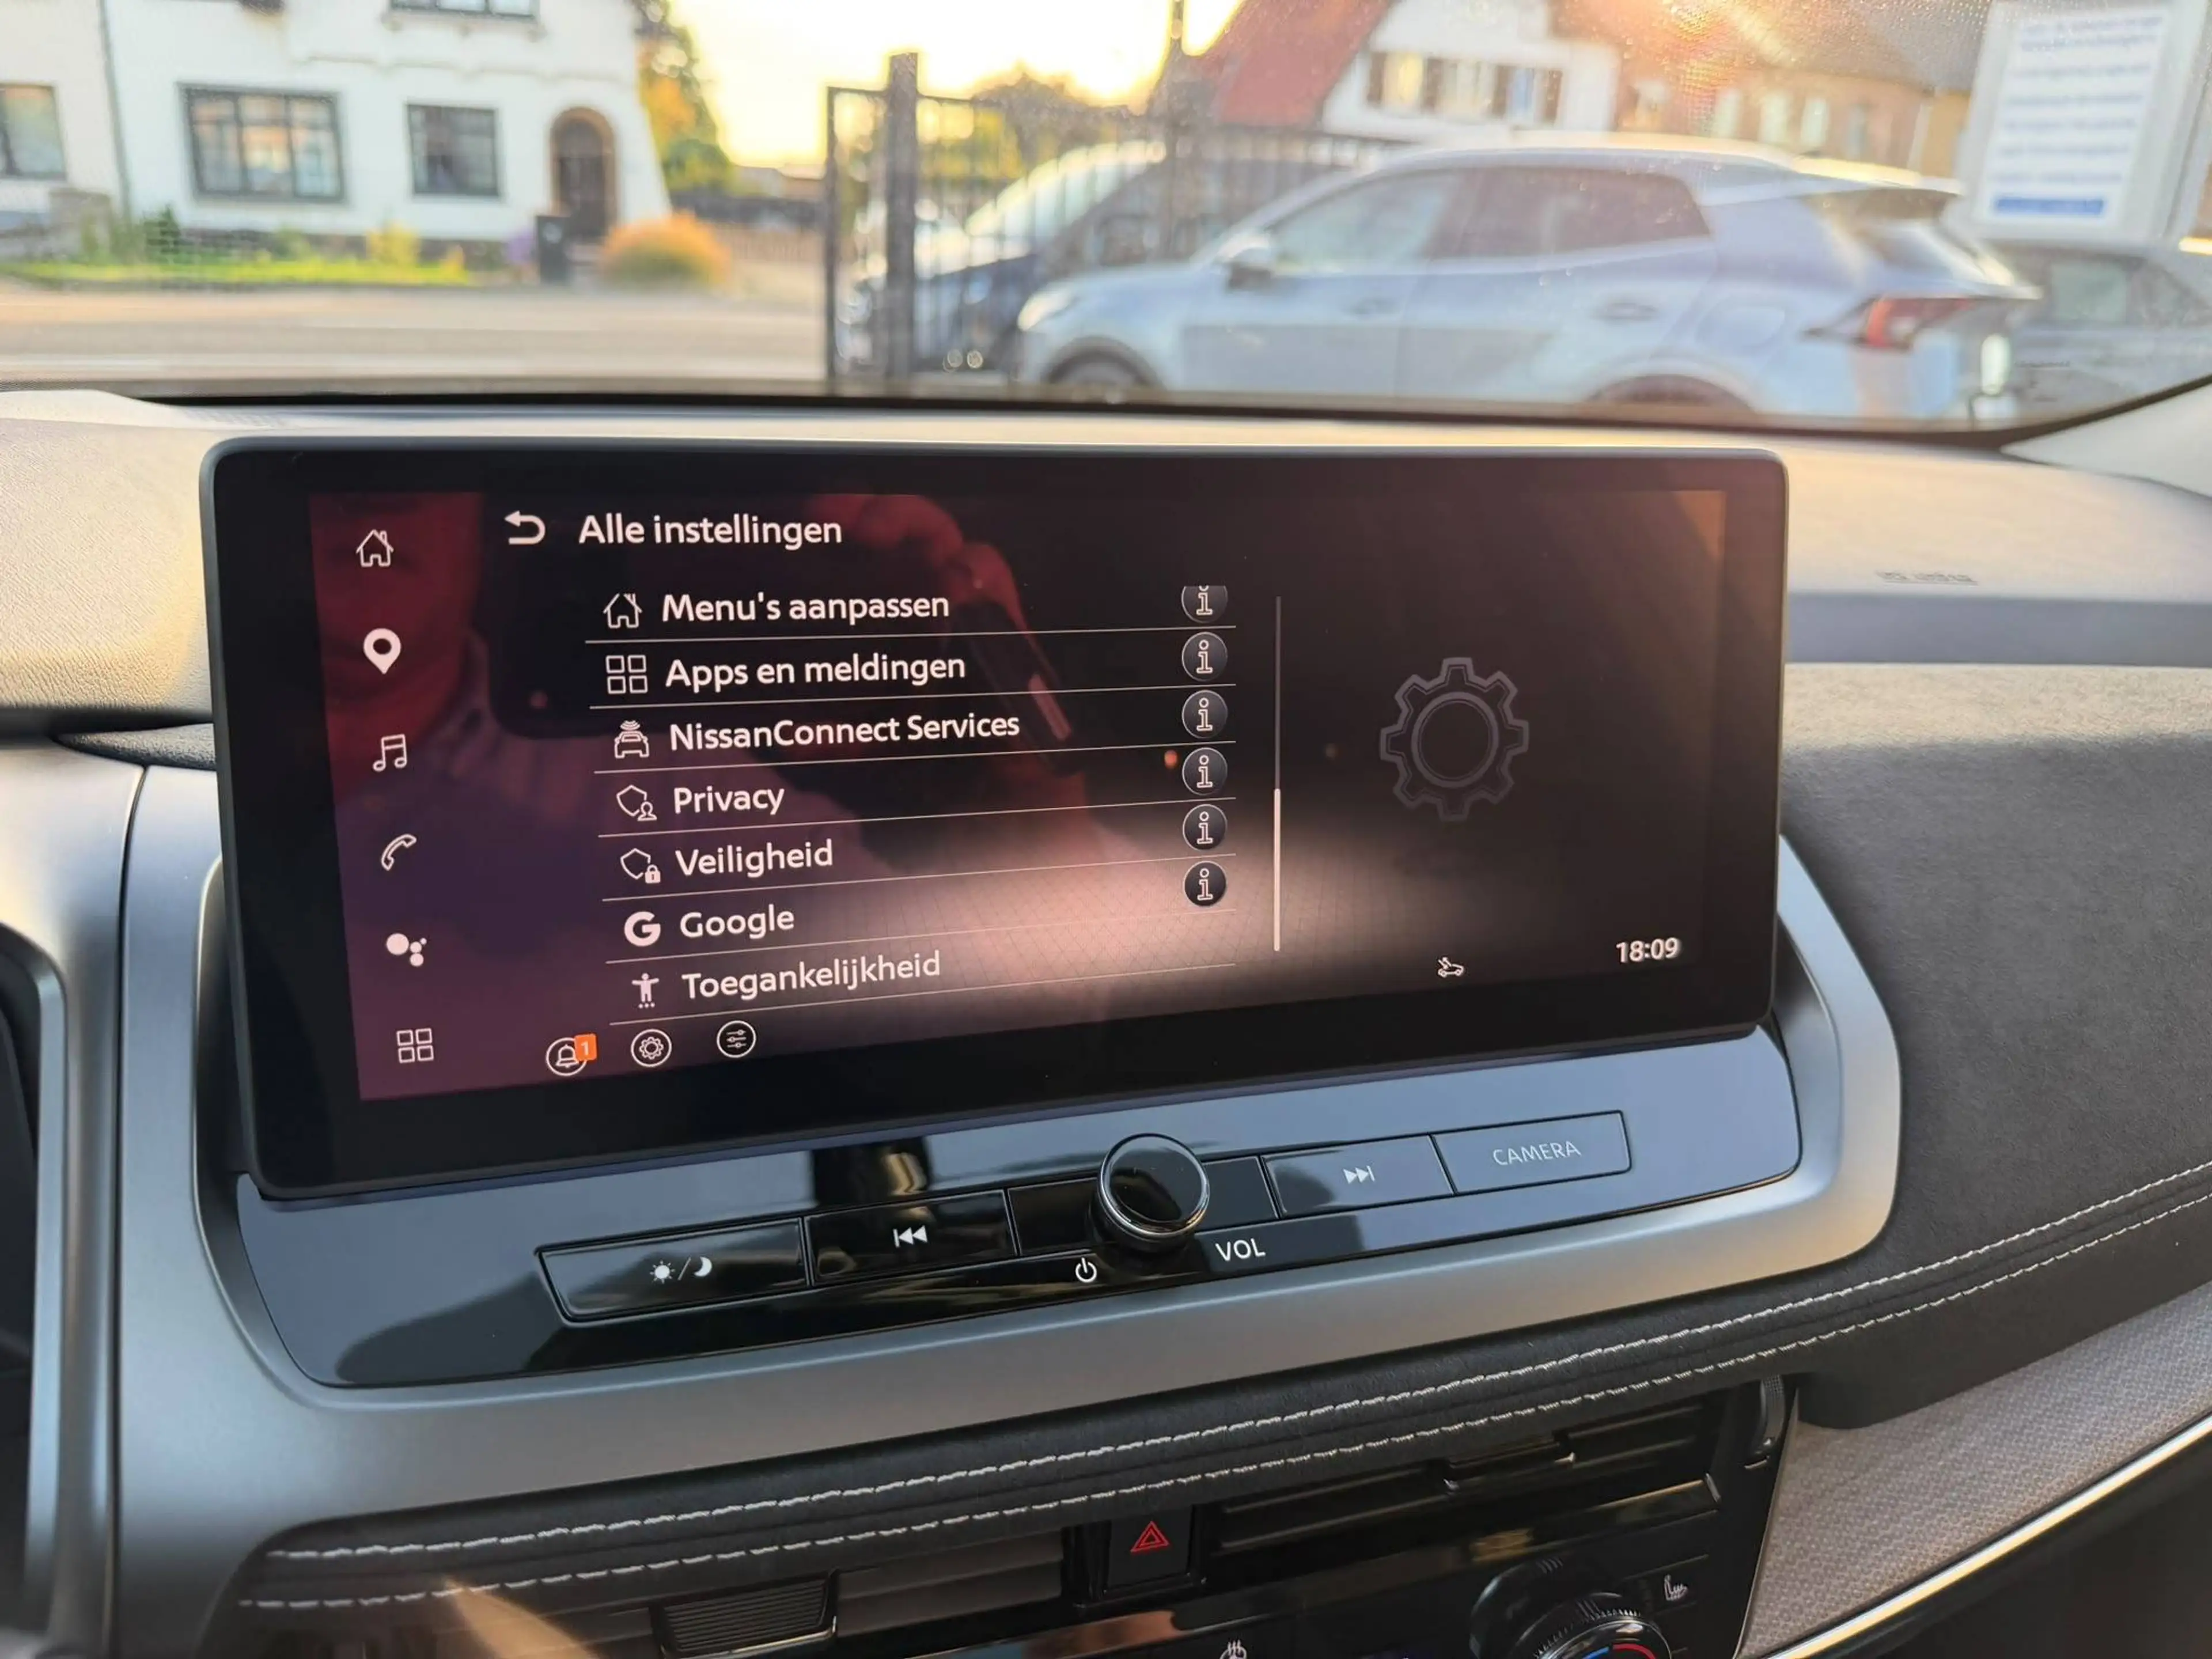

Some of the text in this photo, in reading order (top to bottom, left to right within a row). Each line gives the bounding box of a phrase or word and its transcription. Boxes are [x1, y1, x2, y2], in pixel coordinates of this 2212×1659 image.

[579, 513, 842, 551] Alle instellingen
[662, 592, 949, 626] Menu's aanpassen
[665, 652, 965, 694] Apps en meldingen
[670, 713, 1020, 751] NissanConnect Services
[674, 786, 785, 816] Privacy
[675, 839, 833, 878] Veiligheid
[680, 904, 795, 940] Google
[1616, 937, 1681, 963] 18:09
[681, 950, 941, 1000] Toegankelijkheid
[1493, 1141, 1582, 1166] CAMERA
[1215, 1238, 1266, 1262] VOL
